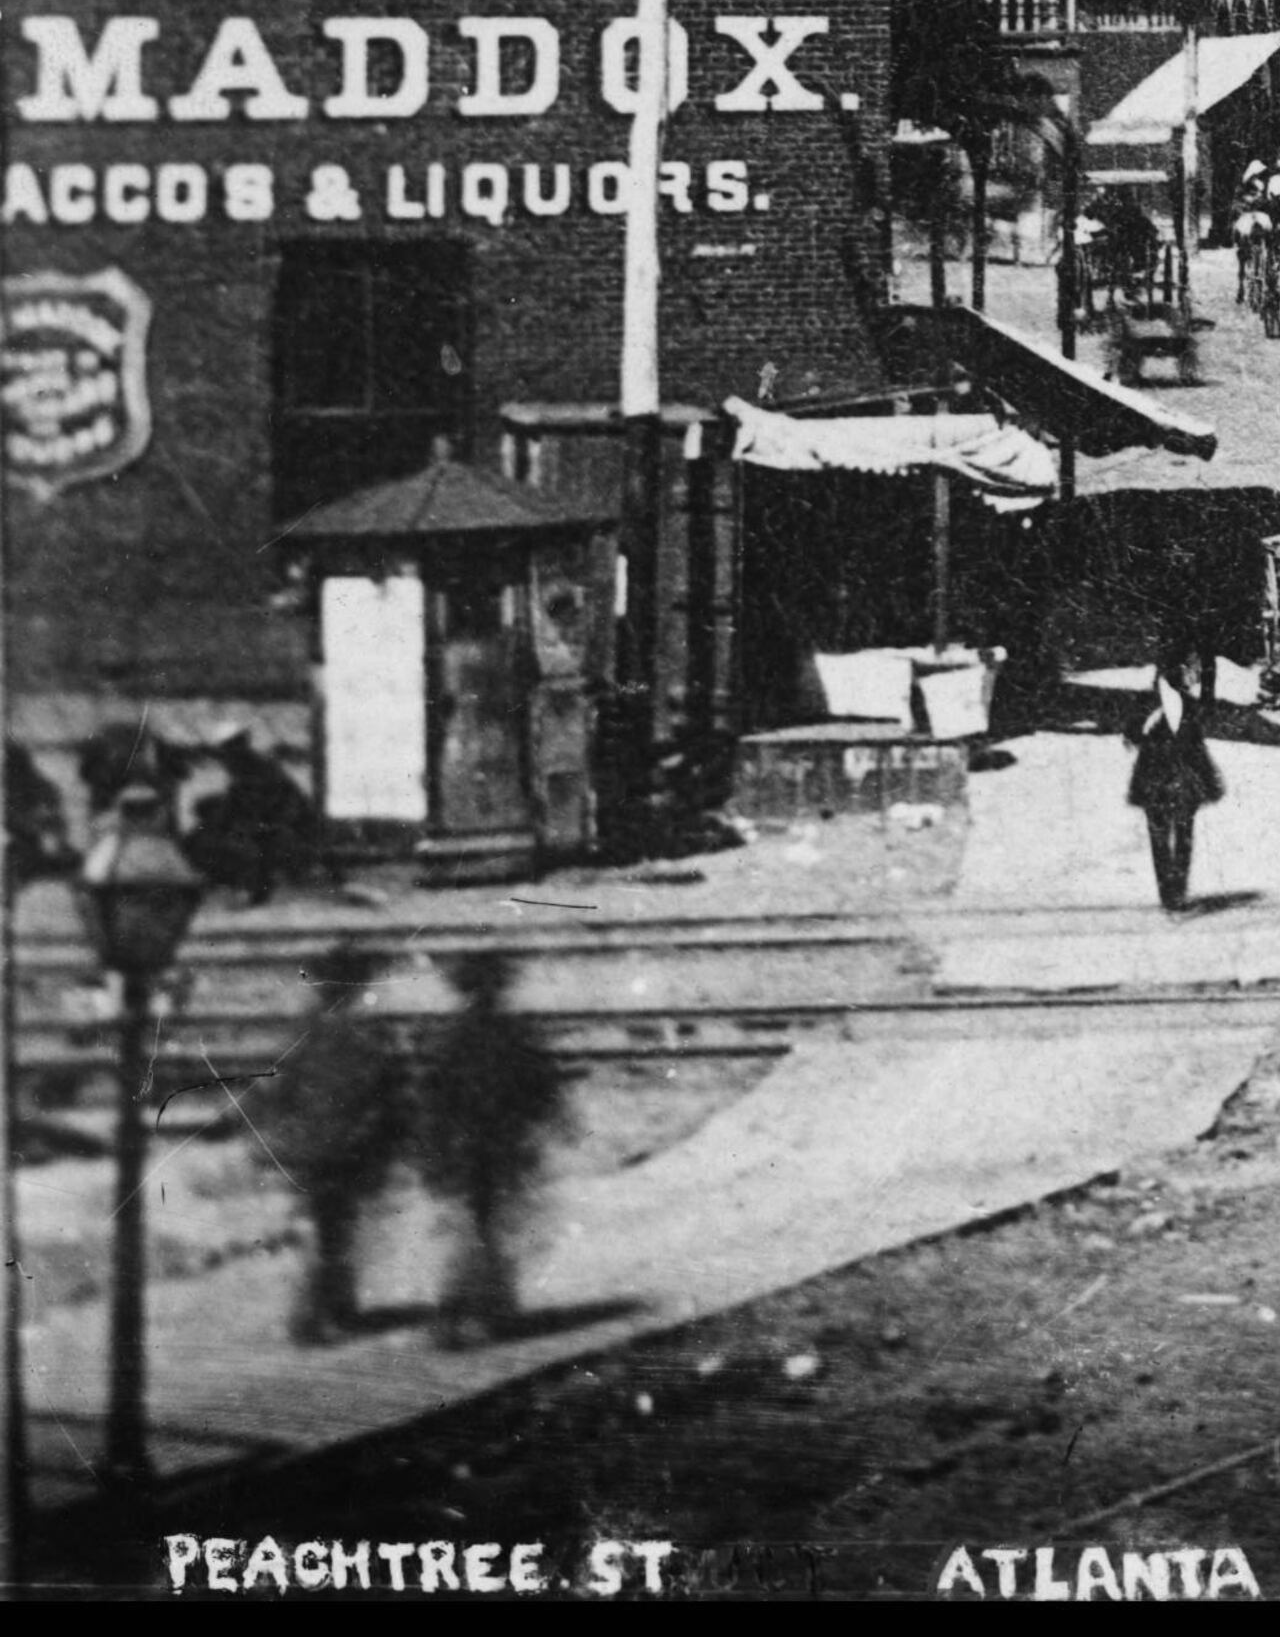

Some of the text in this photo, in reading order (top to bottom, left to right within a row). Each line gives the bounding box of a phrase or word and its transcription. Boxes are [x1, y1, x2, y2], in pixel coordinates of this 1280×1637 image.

[15, 15, 860, 122] MADDOX.
[306, 163, 362, 221] &
[386, 159, 770, 226] LIQUORS.
